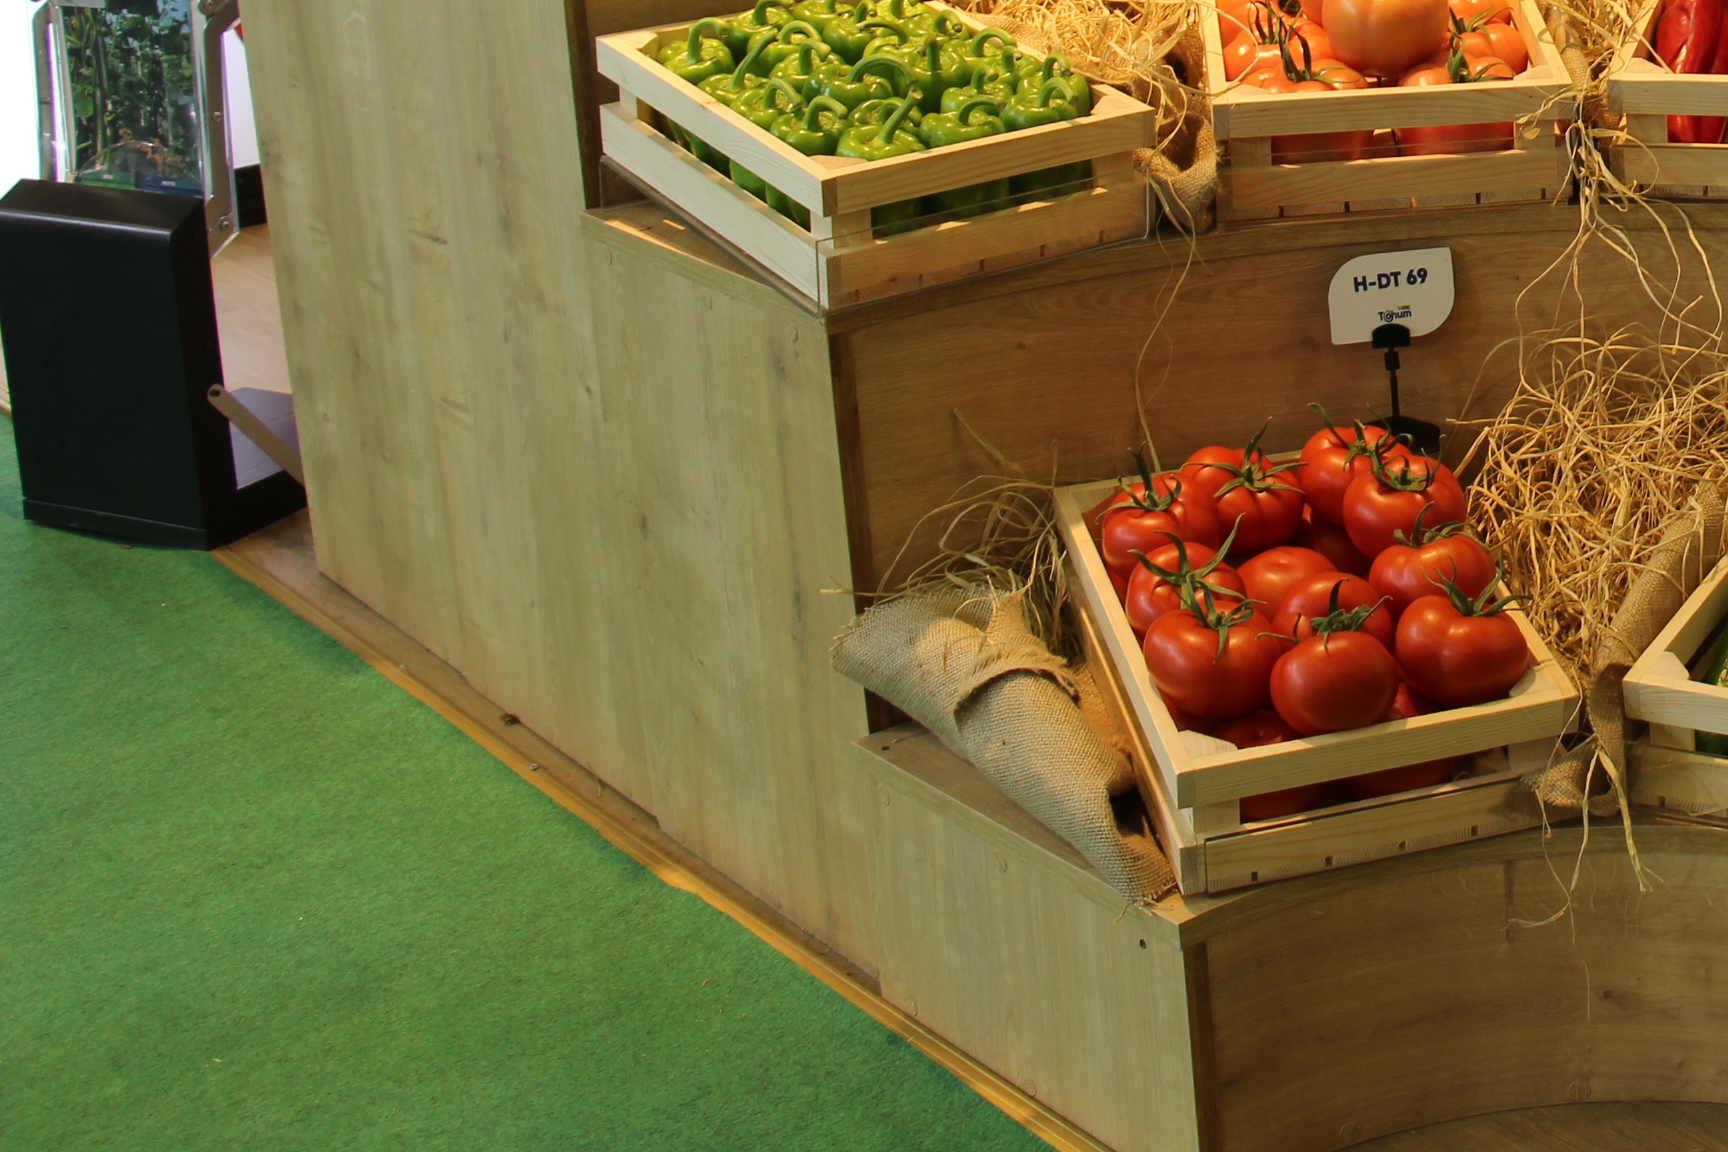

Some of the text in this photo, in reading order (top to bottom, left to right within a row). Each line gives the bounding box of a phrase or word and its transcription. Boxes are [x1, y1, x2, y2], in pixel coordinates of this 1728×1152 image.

[1353, 267, 1428, 293] H-DT 69
[1378, 310, 1412, 323] Tohum
